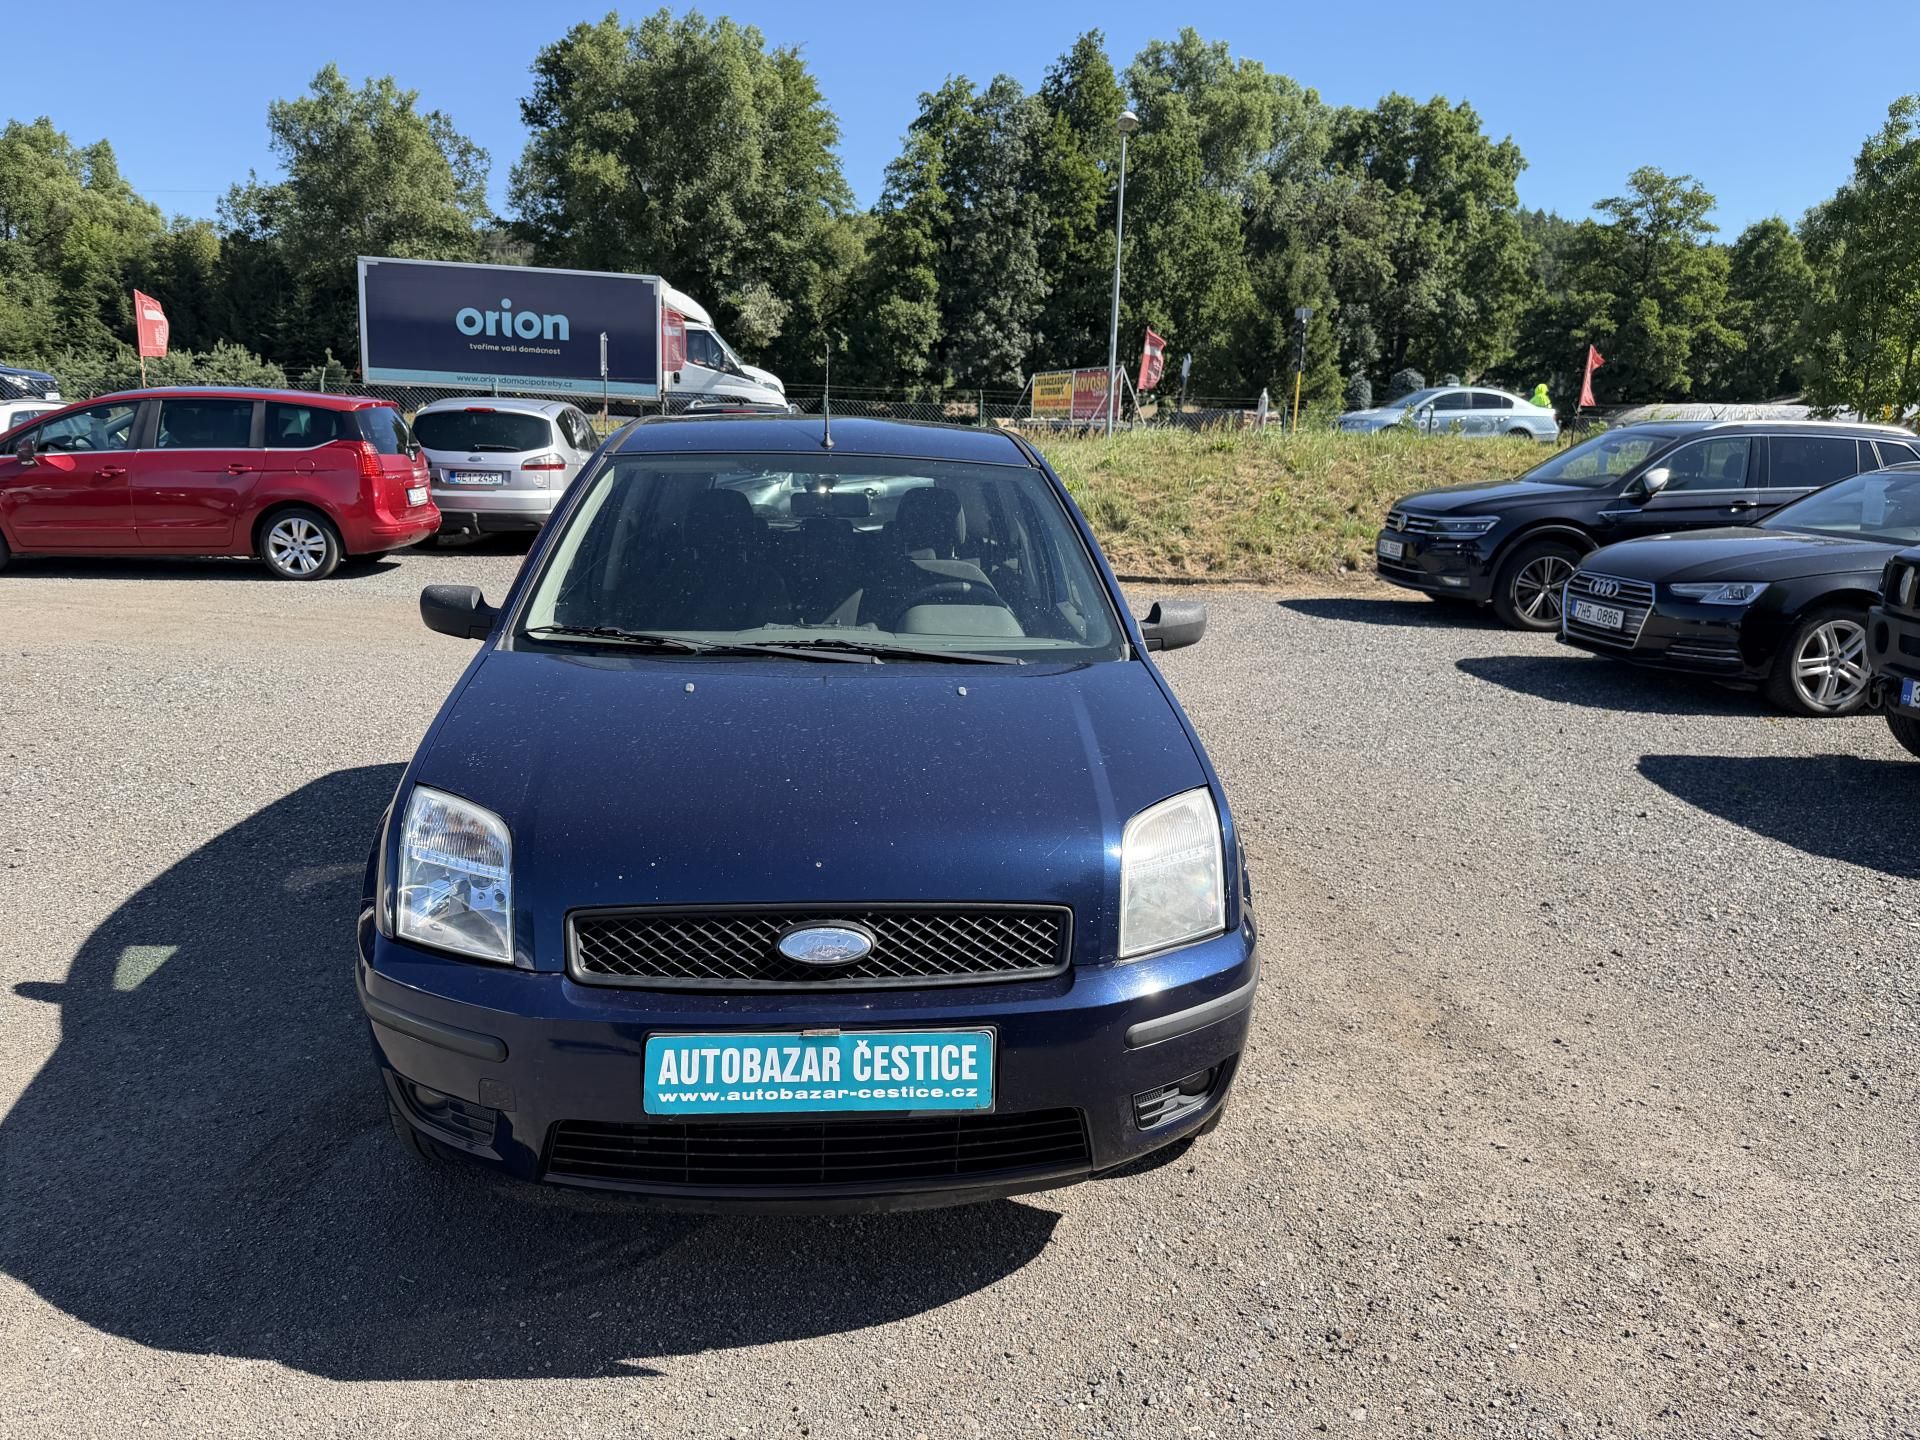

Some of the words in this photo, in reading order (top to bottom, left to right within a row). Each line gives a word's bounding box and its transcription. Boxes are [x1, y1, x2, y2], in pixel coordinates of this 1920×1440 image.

[456, 298, 570, 341] orion
[469, 343, 499, 351] tvoříme
[501, 344, 517, 353] vaši
[519, 345, 561, 355] domácnost
[1577, 603, 1592, 618] 7H5
[1597, 608, 1619, 625] 0886
[657, 1046, 841, 1085] AUTOBAZAR
[852, 1040, 978, 1081] ČESTICE
[658, 1086, 978, 1103] www.autobazar-cestice.cz
